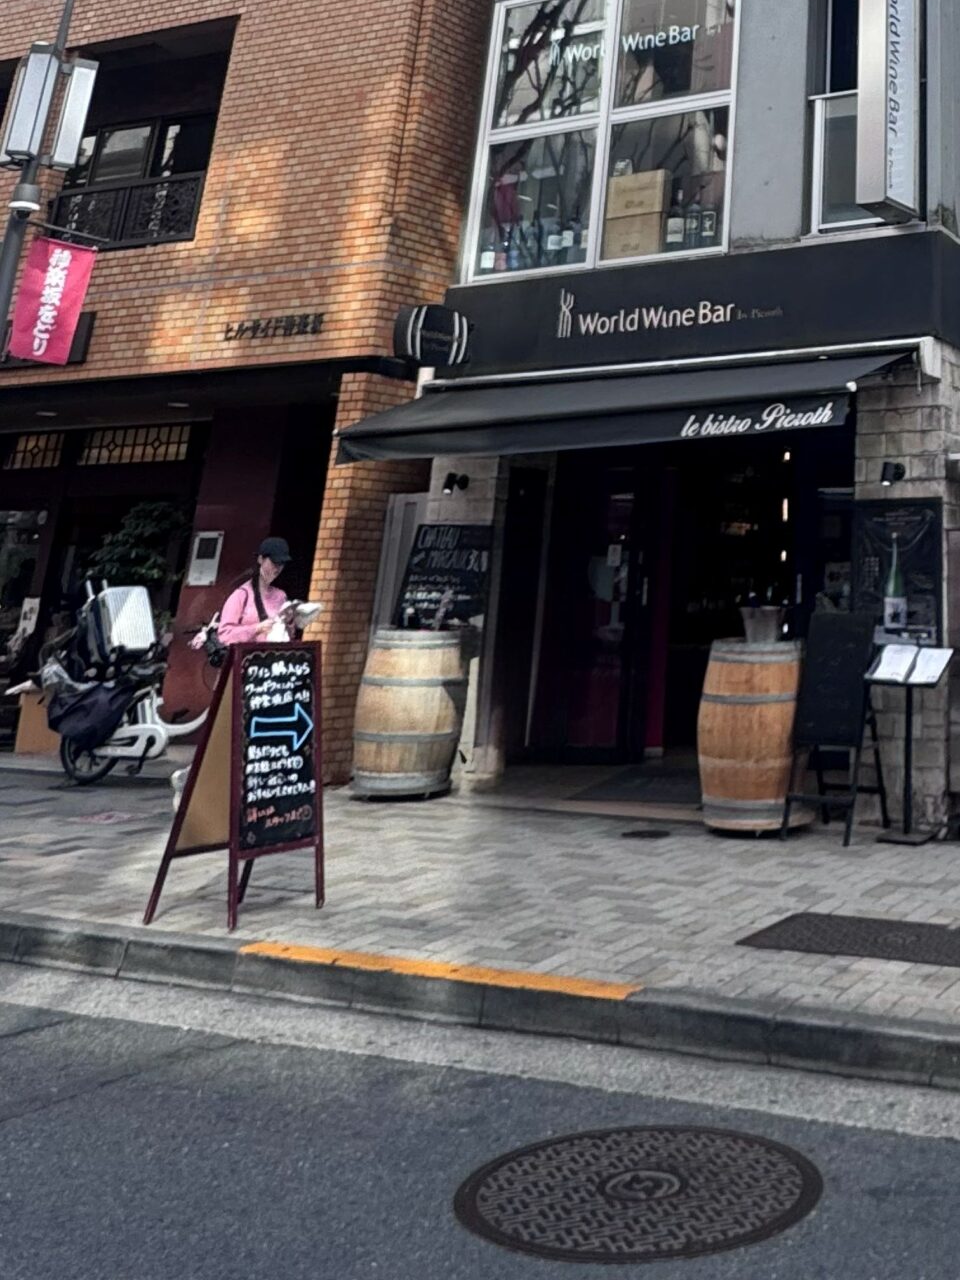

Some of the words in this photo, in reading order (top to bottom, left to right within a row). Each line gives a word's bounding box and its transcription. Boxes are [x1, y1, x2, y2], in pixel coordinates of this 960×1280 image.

[564, 39, 606, 63] Worl
[621, 32, 667, 53] Wine
[668, 25, 700, 45] Bar
[888, 39, 901, 94] Wine
[888, 97, 901, 138] Bar
[578, 307, 640, 336] World
[641, 305, 695, 329] Wine
[698, 300, 736, 325] Bar
[680, 414, 700, 438] le
[701, 412, 752, 436] bistro
[754, 402, 834, 431] Pieroth
